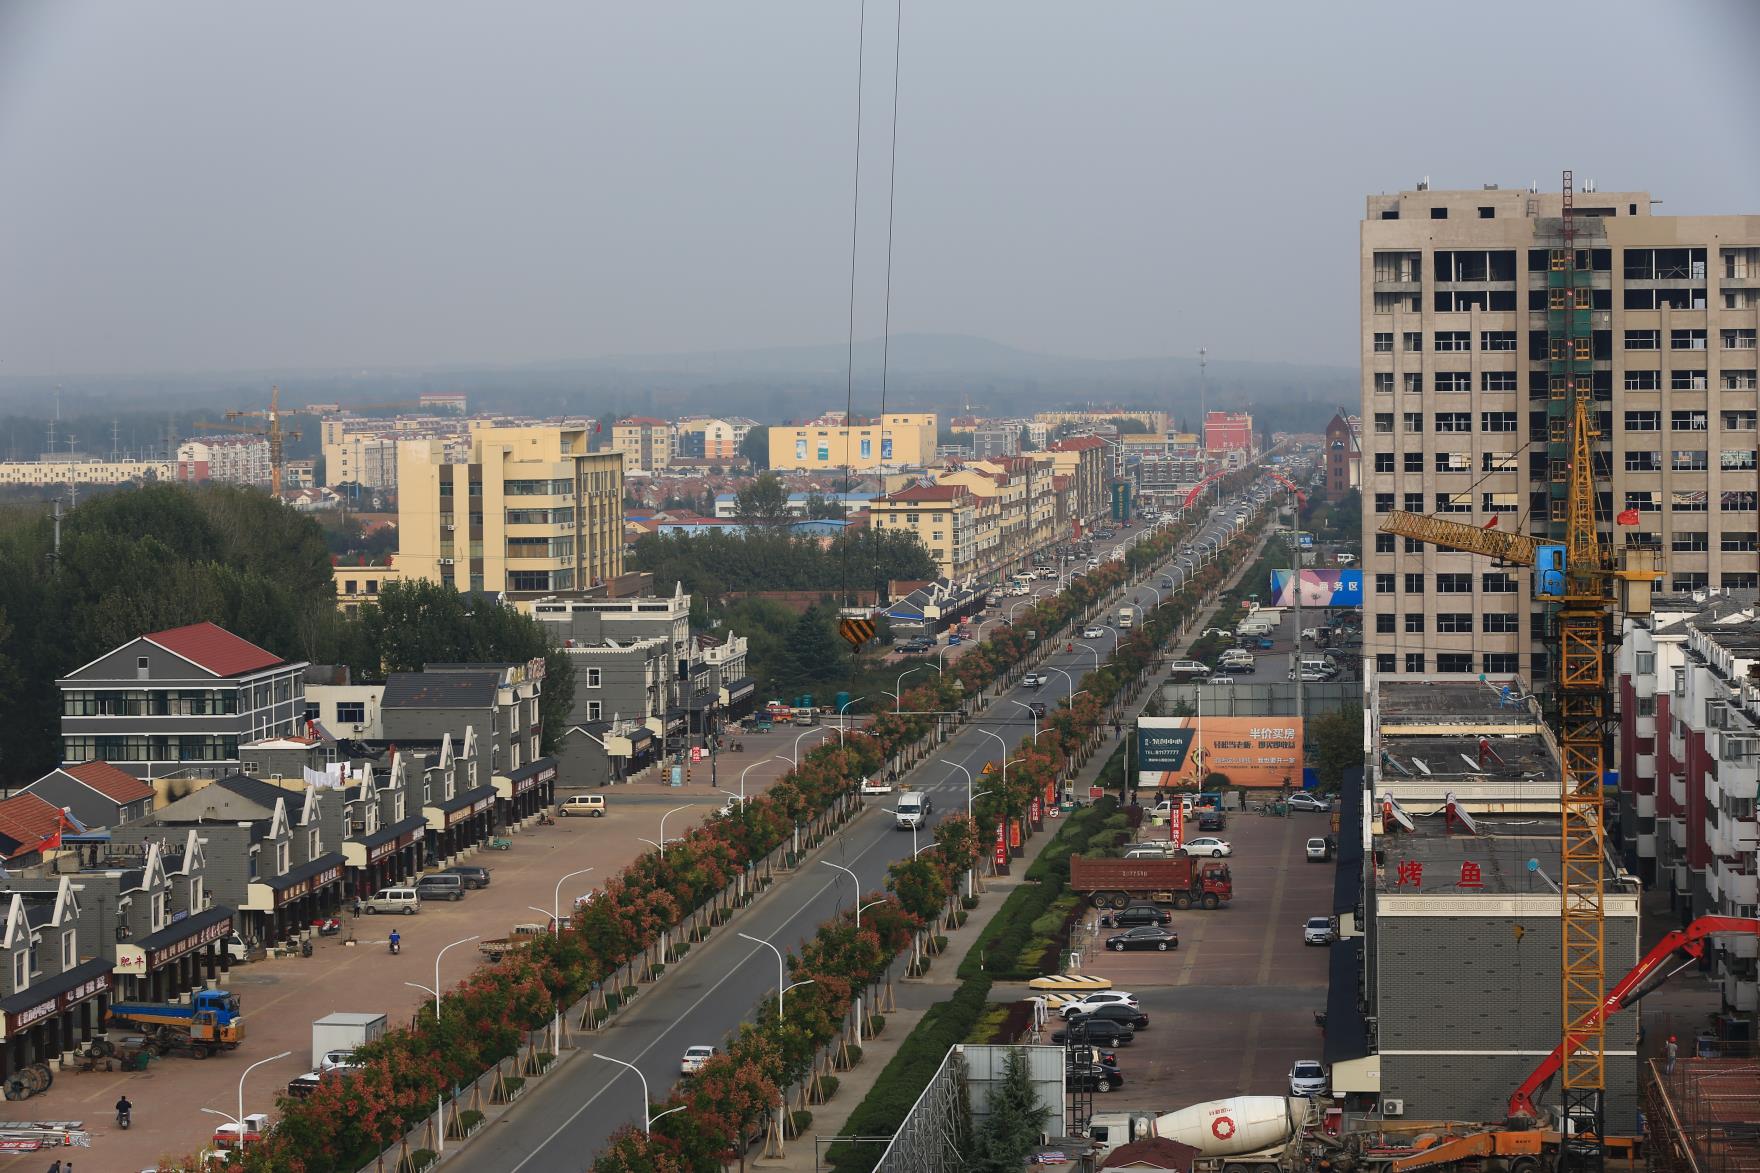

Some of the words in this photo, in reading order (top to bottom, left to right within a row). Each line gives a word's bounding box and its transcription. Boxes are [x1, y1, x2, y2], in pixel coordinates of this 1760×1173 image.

[1249, 727, 1296, 740] 半价买房
[1396, 859, 1487, 887] 烤鱼
[120, 955, 145, 970] 肥牛
